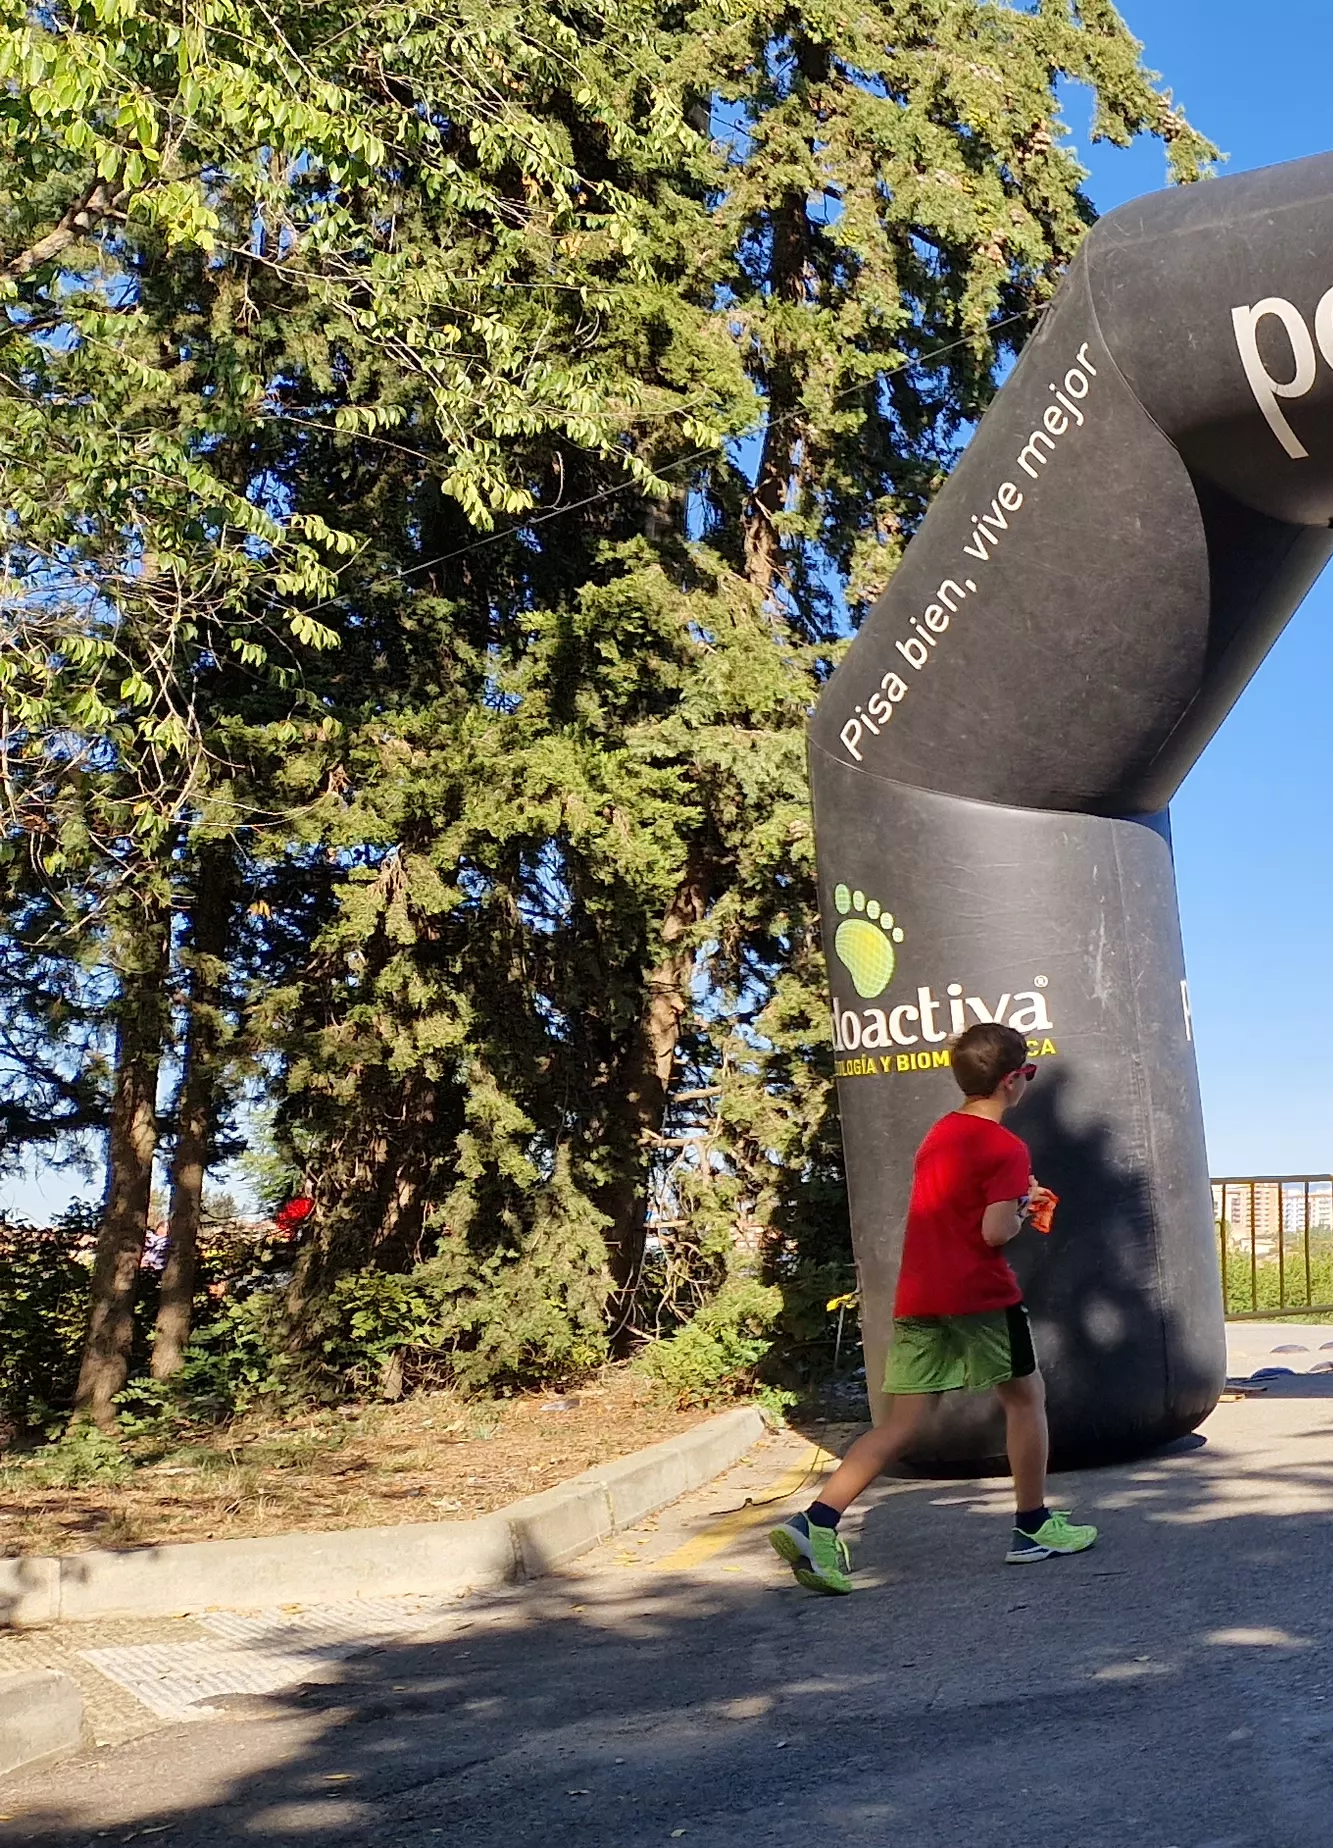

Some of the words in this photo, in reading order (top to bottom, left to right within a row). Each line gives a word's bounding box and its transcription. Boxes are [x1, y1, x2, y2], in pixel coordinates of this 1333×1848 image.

[839, 671, 909, 762] Pisa
[895, 577, 978, 671] bien,
[963, 481, 1025, 562] vive
[1016, 342, 1098, 479] mejor
[879, 1055, 892, 1073] Y
